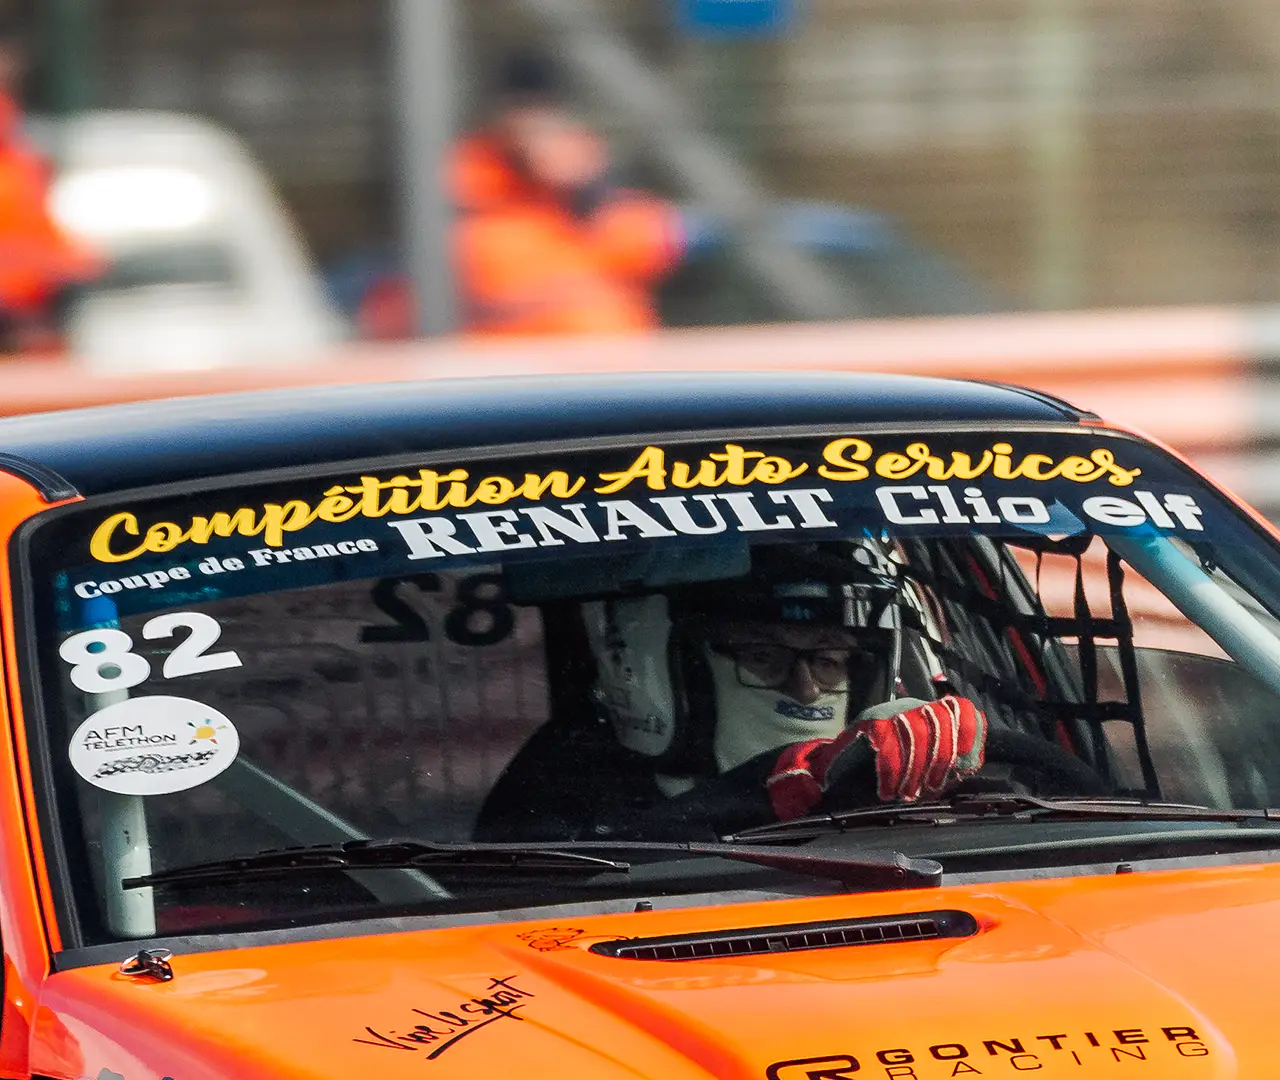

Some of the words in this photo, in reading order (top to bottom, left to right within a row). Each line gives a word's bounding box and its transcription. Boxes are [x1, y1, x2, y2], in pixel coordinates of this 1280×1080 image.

[89, 468, 586, 563] Compétition
[593, 443, 809, 495] Auto
[817, 438, 1141, 486] Services
[875, 485, 1051, 526] Clio
[1083, 491, 1204, 532] elf
[387, 488, 835, 560] RENAULT
[74, 565, 191, 601] Coupe
[198, 556, 245, 576] de
[253, 535, 380, 570] France
[59, 612, 244, 694] 82
[82, 733, 177, 751] TELETHON
[84, 724, 144, 742] AFM
[876, 1025, 1204, 1065] GONTIER
